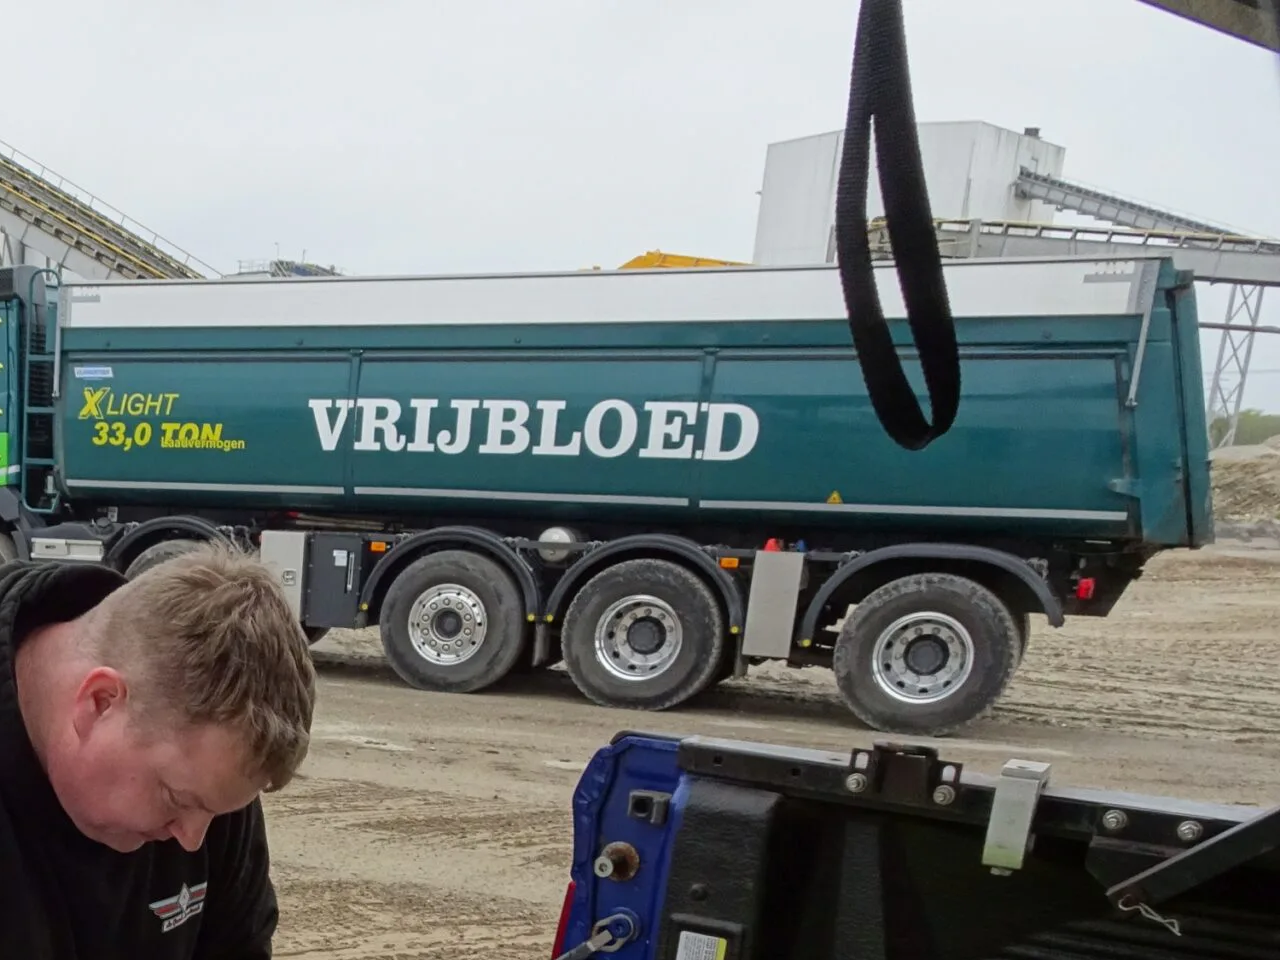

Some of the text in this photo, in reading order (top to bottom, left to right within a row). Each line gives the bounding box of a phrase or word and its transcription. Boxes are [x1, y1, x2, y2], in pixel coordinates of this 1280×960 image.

[92, 422, 223, 451] 33,0 TON
[308, 398, 760, 460] VRIJBLOED
